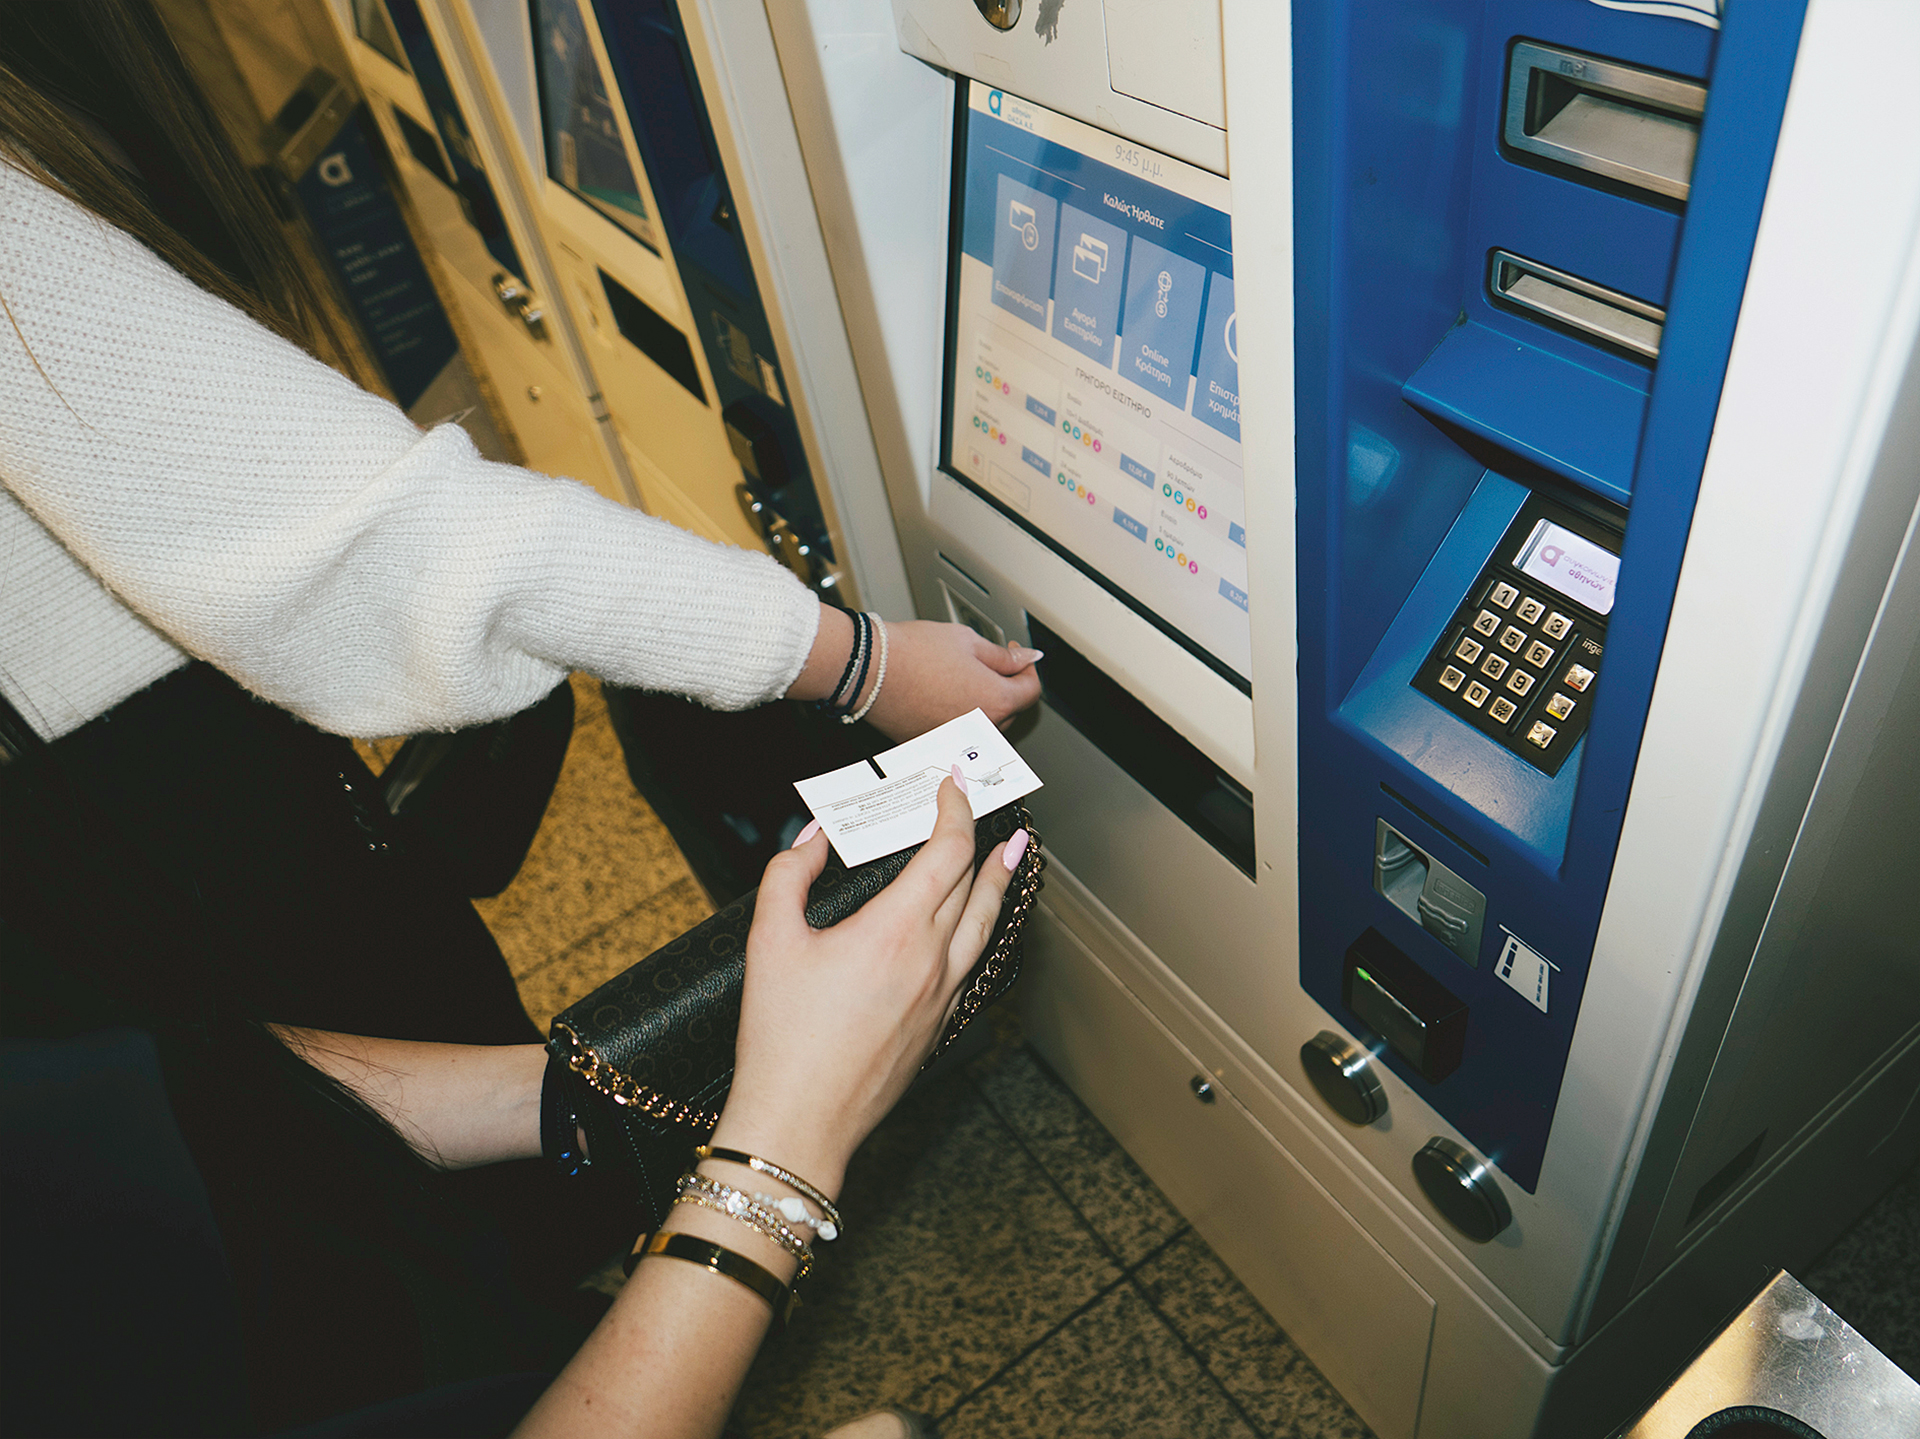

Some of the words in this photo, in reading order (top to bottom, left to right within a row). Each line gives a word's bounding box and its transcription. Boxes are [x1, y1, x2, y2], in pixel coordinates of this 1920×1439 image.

[1115, 144, 1140, 167] 9:45
[1141, 158, 1163, 178] μ.μ.
[1103, 192, 1131, 218] Καλώς
[1131, 204, 1165, 230] Ήρθατε
[1071, 307, 1097, 329] Αγορά
[1141, 344, 1170, 368] Online
[1135, 356, 1172, 388] Κράτηση
[1075, 367, 1112, 395] ΓΡΗΓΟΡΟ
[1112, 389, 1151, 419] ΕΙΣΙΤΗΡΙΟ
[1209, 380, 1241, 406] Επιστρ
[1208, 398, 1241, 424] χρημάτ
[1568, 568, 1605, 591] αθηνών
[1501, 590, 1510, 603] 1
[1522, 603, 1537, 619] 2
[1480, 617, 1493, 631] 4
[1550, 618, 1564, 633] 3
[1505, 631, 1520, 646] 5
[1463, 643, 1476, 657] 7
[1532, 647, 1546, 662] 6
[1488, 659, 1500, 674] 8
[1513, 675, 1526, 690] 9
[1577, 678, 1585, 687] A
[1470, 686, 1482, 701] 0
[1541, 734, 1549, 742] V
